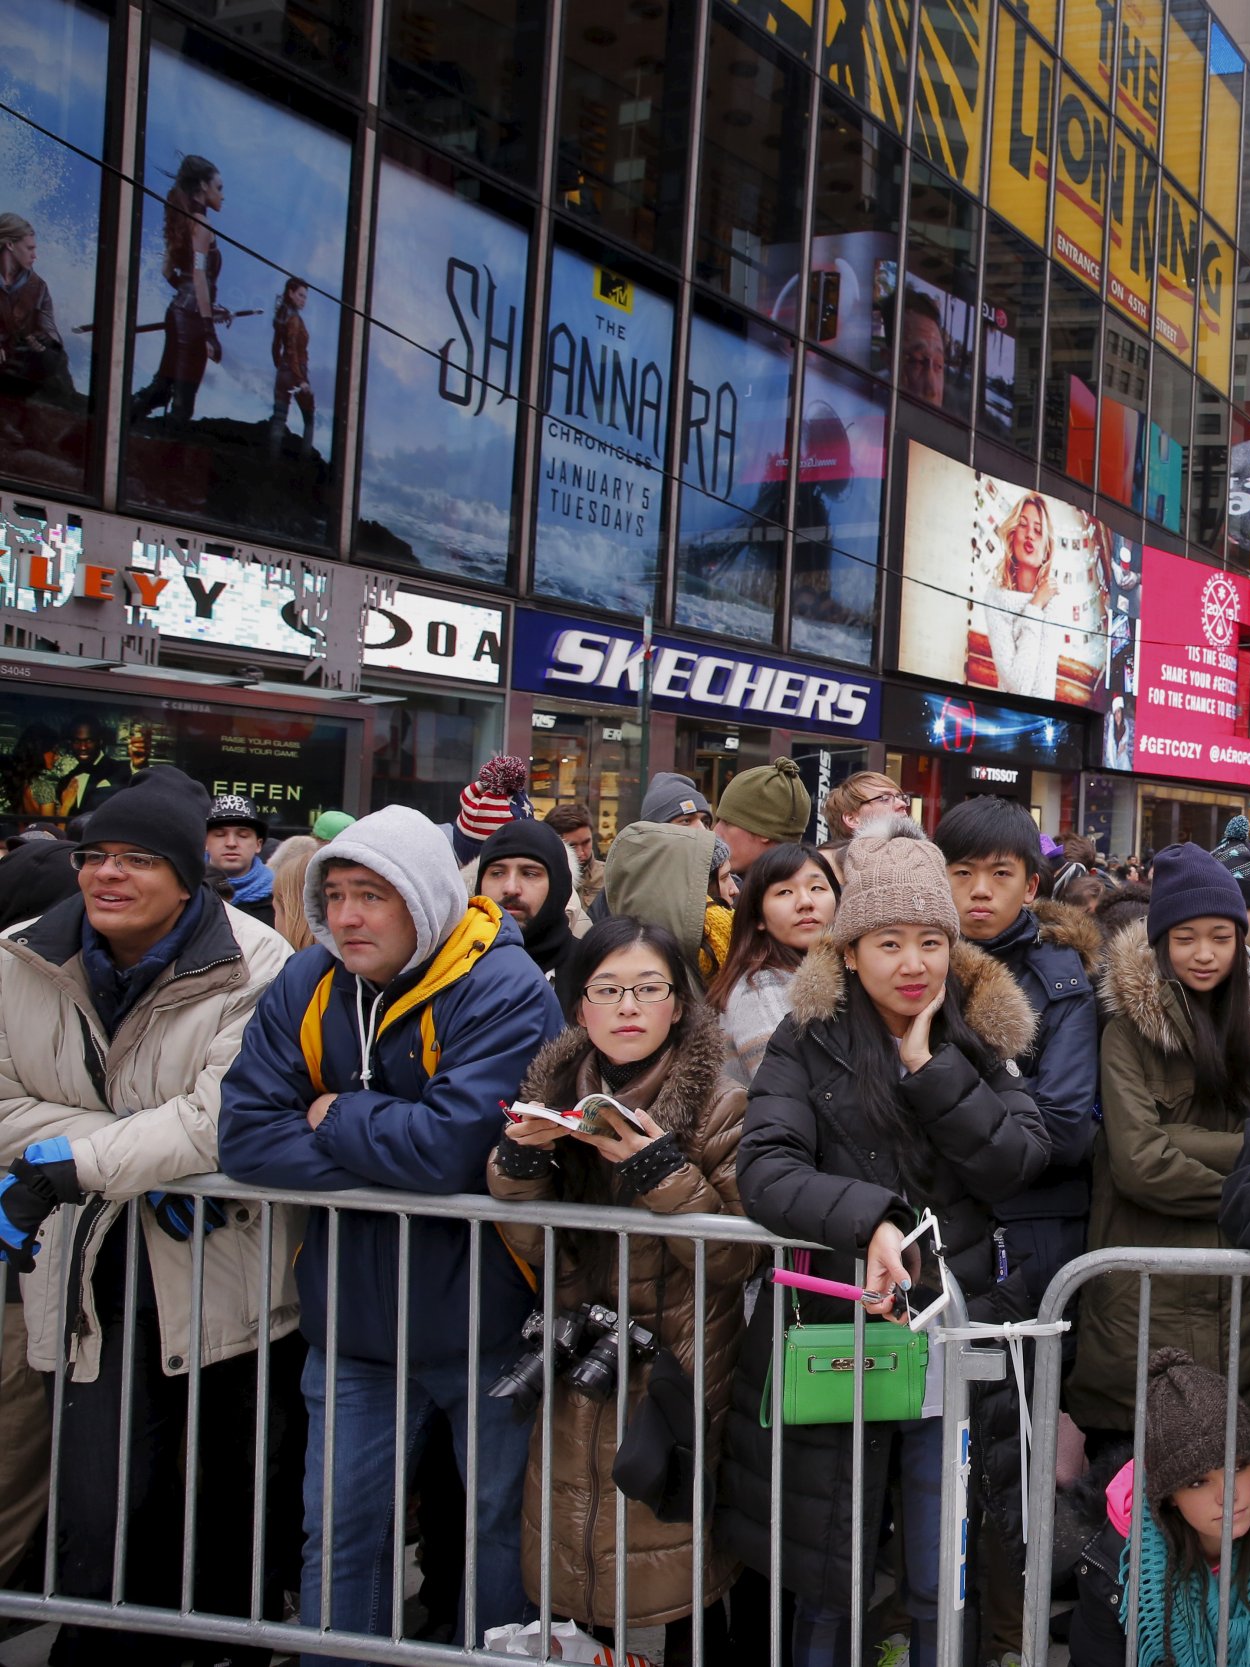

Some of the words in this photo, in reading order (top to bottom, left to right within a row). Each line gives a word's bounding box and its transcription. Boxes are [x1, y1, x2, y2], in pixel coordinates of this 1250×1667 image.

[1009, 2, 1125, 227] LION
[1129, 131, 1223, 319] KING
[1056, 233, 1101, 281] ENTRANCE
[1110, 280, 1125, 301] ON
[1127, 295, 1147, 320] 45TH
[1155, 318, 1178, 344] STREET
[595, 314, 627, 341] THE
[545, 457, 634, 496] JANUARY
[640, 487, 650, 510] 5
[551, 489, 646, 538] TUESDAYS
[1202, 648, 1217, 667] THE
[544, 629, 872, 726] SKECHERS
[1160, 663, 1188, 684] SHARE
[1189, 670, 1212, 692] YOUR
[1148, 687, 1165, 706] FOR
[1167, 690, 1183, 709] THE
[1185, 694, 1216, 715] CHANCE
[220, 735, 247, 744] RAISE
[247, 738, 272, 747] YOUR
[221, 745, 248, 754] RAISE
[248, 748, 273, 756] YOUR
[1138, 735, 1203, 760] #GETCOZY
[987, 769, 1019, 783] TISSOT
[213, 781, 301, 801] EFFEN
[215, 794, 249, 808] HAPPY
